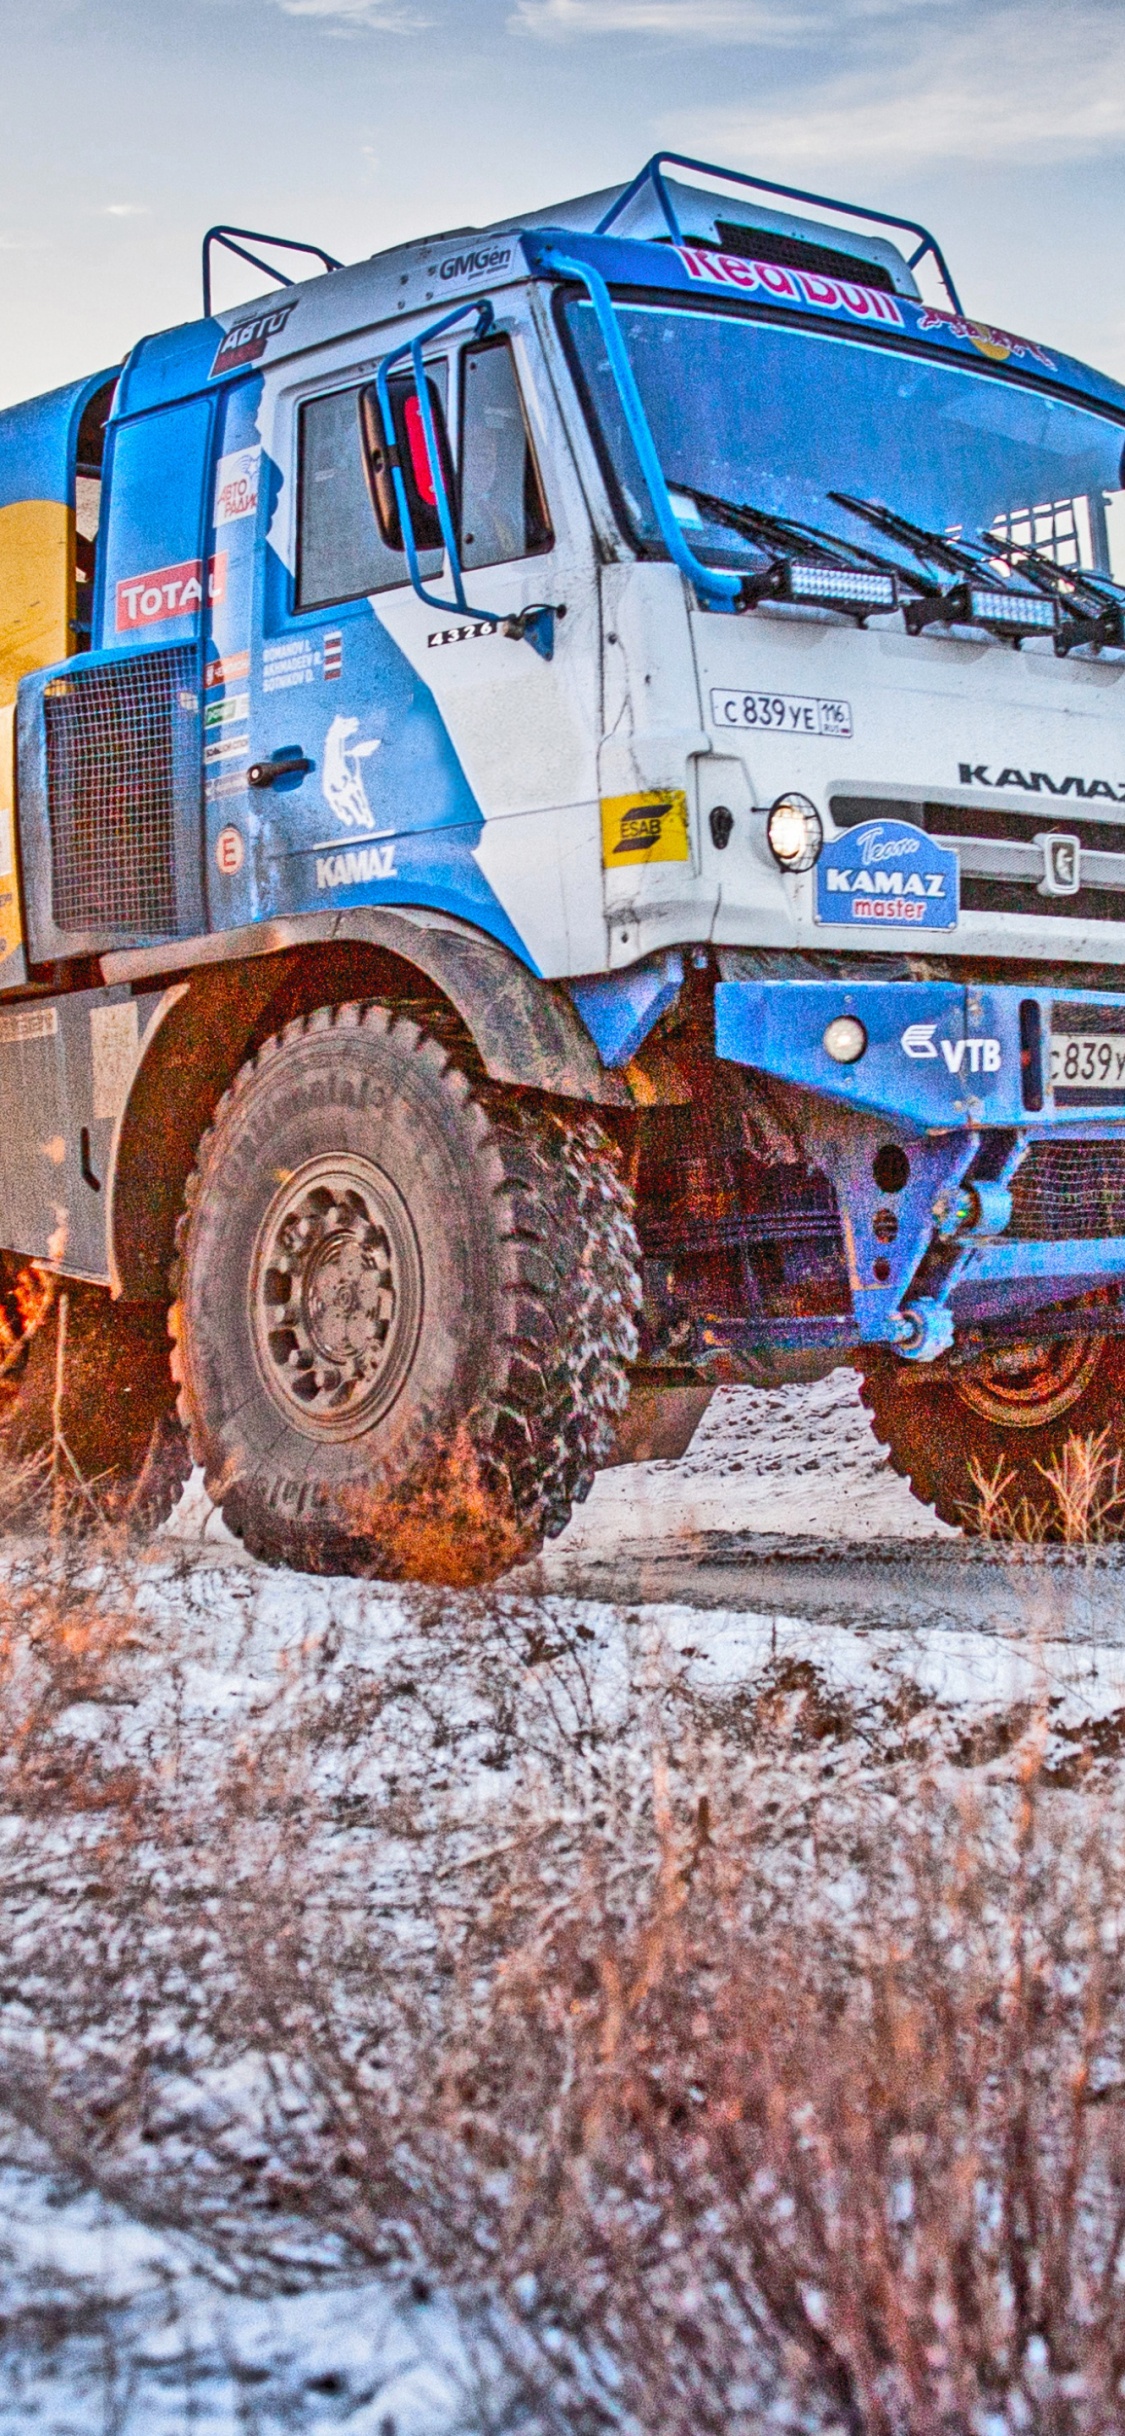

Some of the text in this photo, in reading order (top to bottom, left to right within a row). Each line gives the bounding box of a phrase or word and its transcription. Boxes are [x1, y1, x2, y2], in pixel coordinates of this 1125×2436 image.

[121, 573, 222, 621] TOTAL
[430, 621, 494, 646] 4326
[958, 763, 1125, 803] KAMA
[620, 819, 662, 837] ESAB
[856, 826, 921, 866] Team
[316, 845, 397, 889] KAMAZ
[826, 868, 946, 898] KAMAZ
[852, 898, 926, 919] master
[940, 1038, 1001, 1073] VTB
